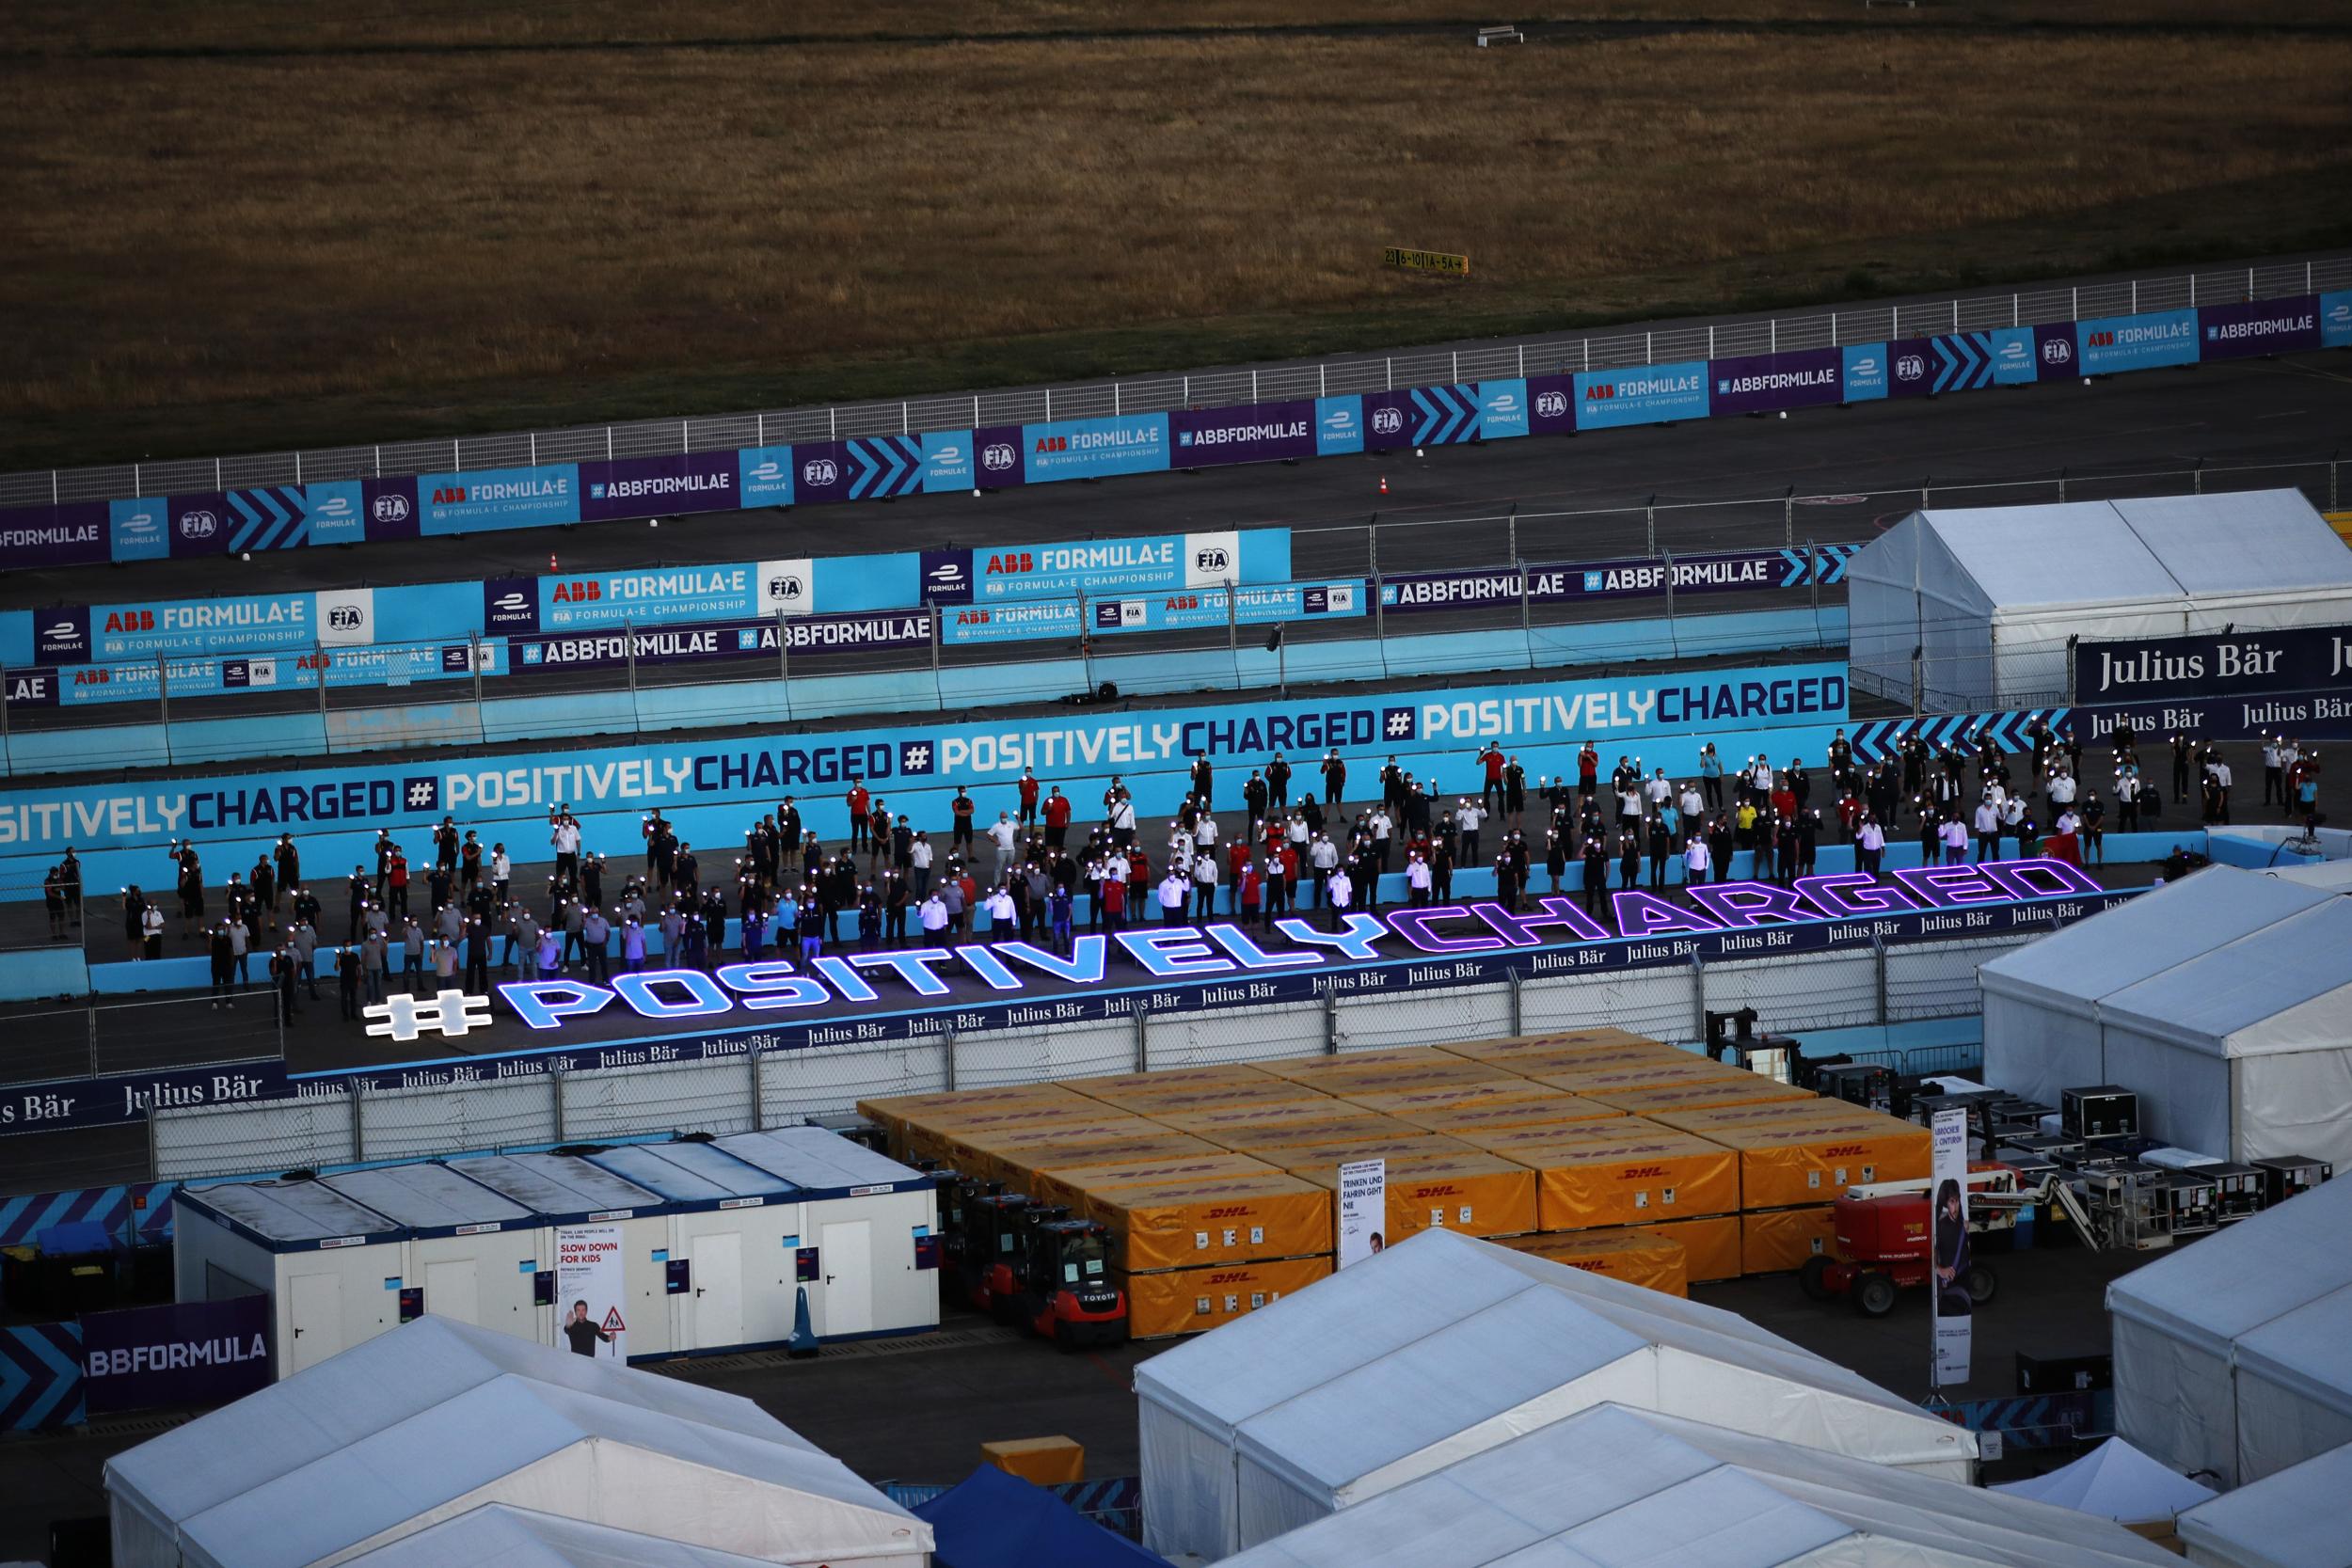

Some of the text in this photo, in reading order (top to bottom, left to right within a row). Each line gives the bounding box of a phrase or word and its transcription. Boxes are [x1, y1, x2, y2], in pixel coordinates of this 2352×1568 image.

[2089, 331, 2114, 347] ABB
[1586, 384, 1614, 400] ABB
[1036, 436, 1067, 452] ABB
[432, 486, 467, 505] ABB
[986, 552, 1033, 575] ABB
[1084, 572, 1174, 587] CHAMPIONSHIP
[552, 581, 601, 604] ABB
[1166, 595, 1198, 610] ABB
[654, 600, 746, 616] CHAMPIONSHIP
[957, 610, 990, 626] ABB
[104, 610, 155, 633] ABB
[209, 630, 307, 646] CHAMPIONSHIP
[74, 669, 109, 686] ABB
[2100, 643, 2283, 691] Julius Bär
[2091, 708, 2204, 739] Julus Bär
[2242, 698, 2352, 729] Julius Bär
[1921, 911, 1993, 934] Julius Bär
[2012, 907, 2054, 926] Julius
[2058, 903, 2084, 919] Bär
[1721, 930, 1794, 954] Julius Bär
[1828, 921, 1900, 943] Julius Bär
[1533, 949, 1606, 973] Julius Bär
[1627, 940, 1700, 963] Julius Bär
[1312, 972, 1388, 994] Julius Bär
[1408, 961, 1483, 984] Julius Bär
[1104, 992, 1181, 1017] Julis Bär
[1201, 983, 1278, 1007] Julius Bär
[908, 1013, 985, 1037] Julius Bär
[1007, 1003, 1084, 1027] Julius Bär
[808, 1023, 886, 1047] Julius Bär
[702, 1034, 781, 1059] Julius Bär
[497, 1055, 578, 1080] Julius är
[599, 1046, 679, 1070] Julius Bär
[356, 1077, 379, 1093] är
[453, 1066, 484, 1085] Bär
[125, 1074, 262, 1117] Julius Bär
[24, 1095, 75, 1122] Bär
[1825, 1145, 1864, 1158] DHL
[1343, 1176, 1383, 1188] TRINKEN UND
[1624, 1166, 1663, 1180] DHL
[1343, 1187, 1382, 1199] FAHREN GEHT
[1416, 1184, 1456, 1199] DHL
[1209, 1206, 1249, 1219] DHL
[560, 1243, 618, 1253] SLOW DOWN
[560, 1255, 601, 1264] FOR KIDS
[1211, 1272, 1249, 1285] DHL
[1084, 1292, 1116, 1302] TOYOTA
[82, 1333, 267, 1378] BBFORMULA
